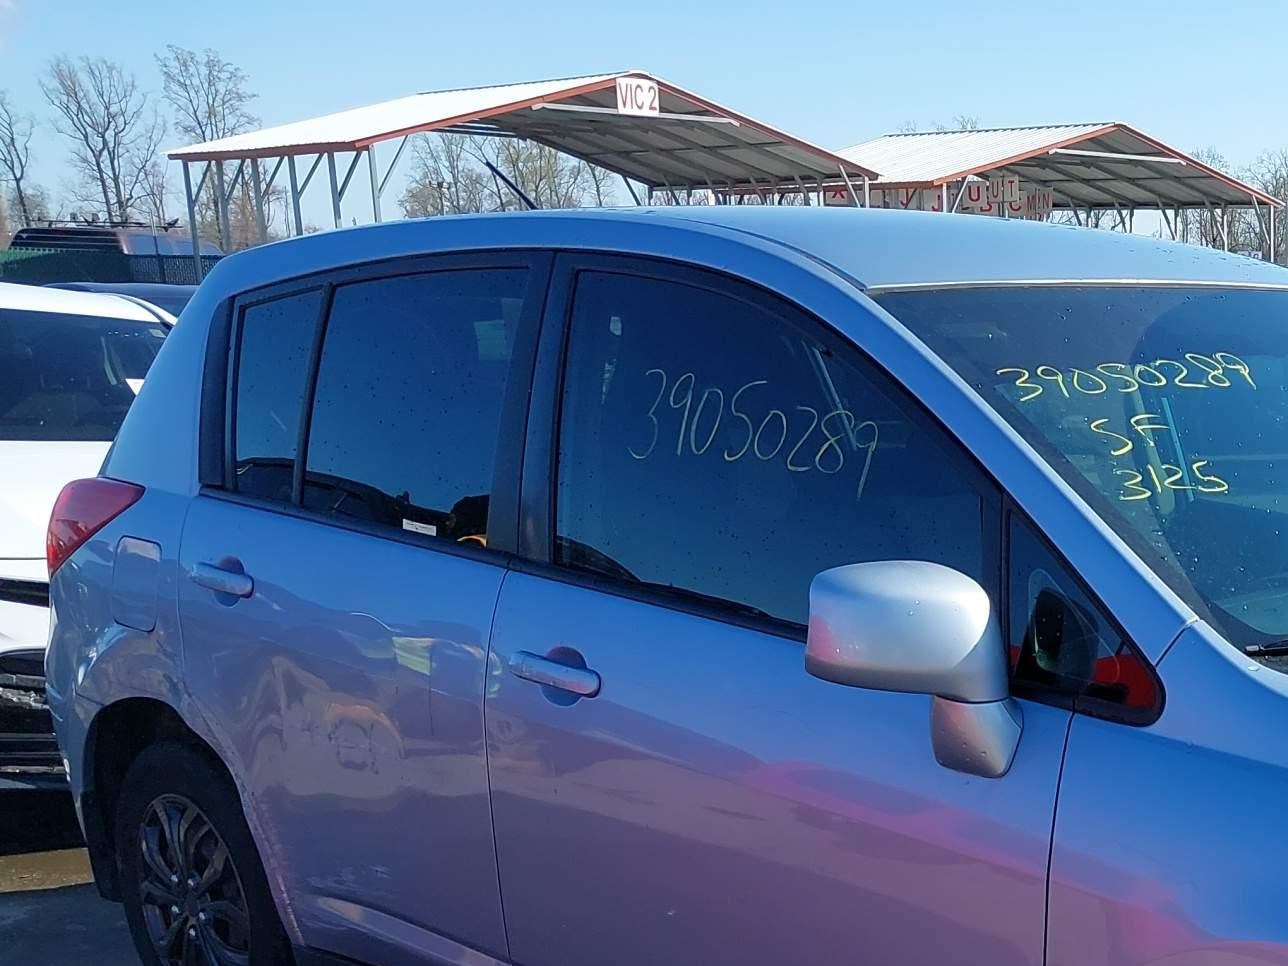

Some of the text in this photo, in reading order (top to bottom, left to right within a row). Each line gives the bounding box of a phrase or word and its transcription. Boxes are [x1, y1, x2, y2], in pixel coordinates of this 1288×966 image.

[618, 83, 657, 111] VIC 2
[968, 186, 981, 202] U
[996, 353, 1257, 402] 39050289
[628, 369, 879, 501] 39050289
